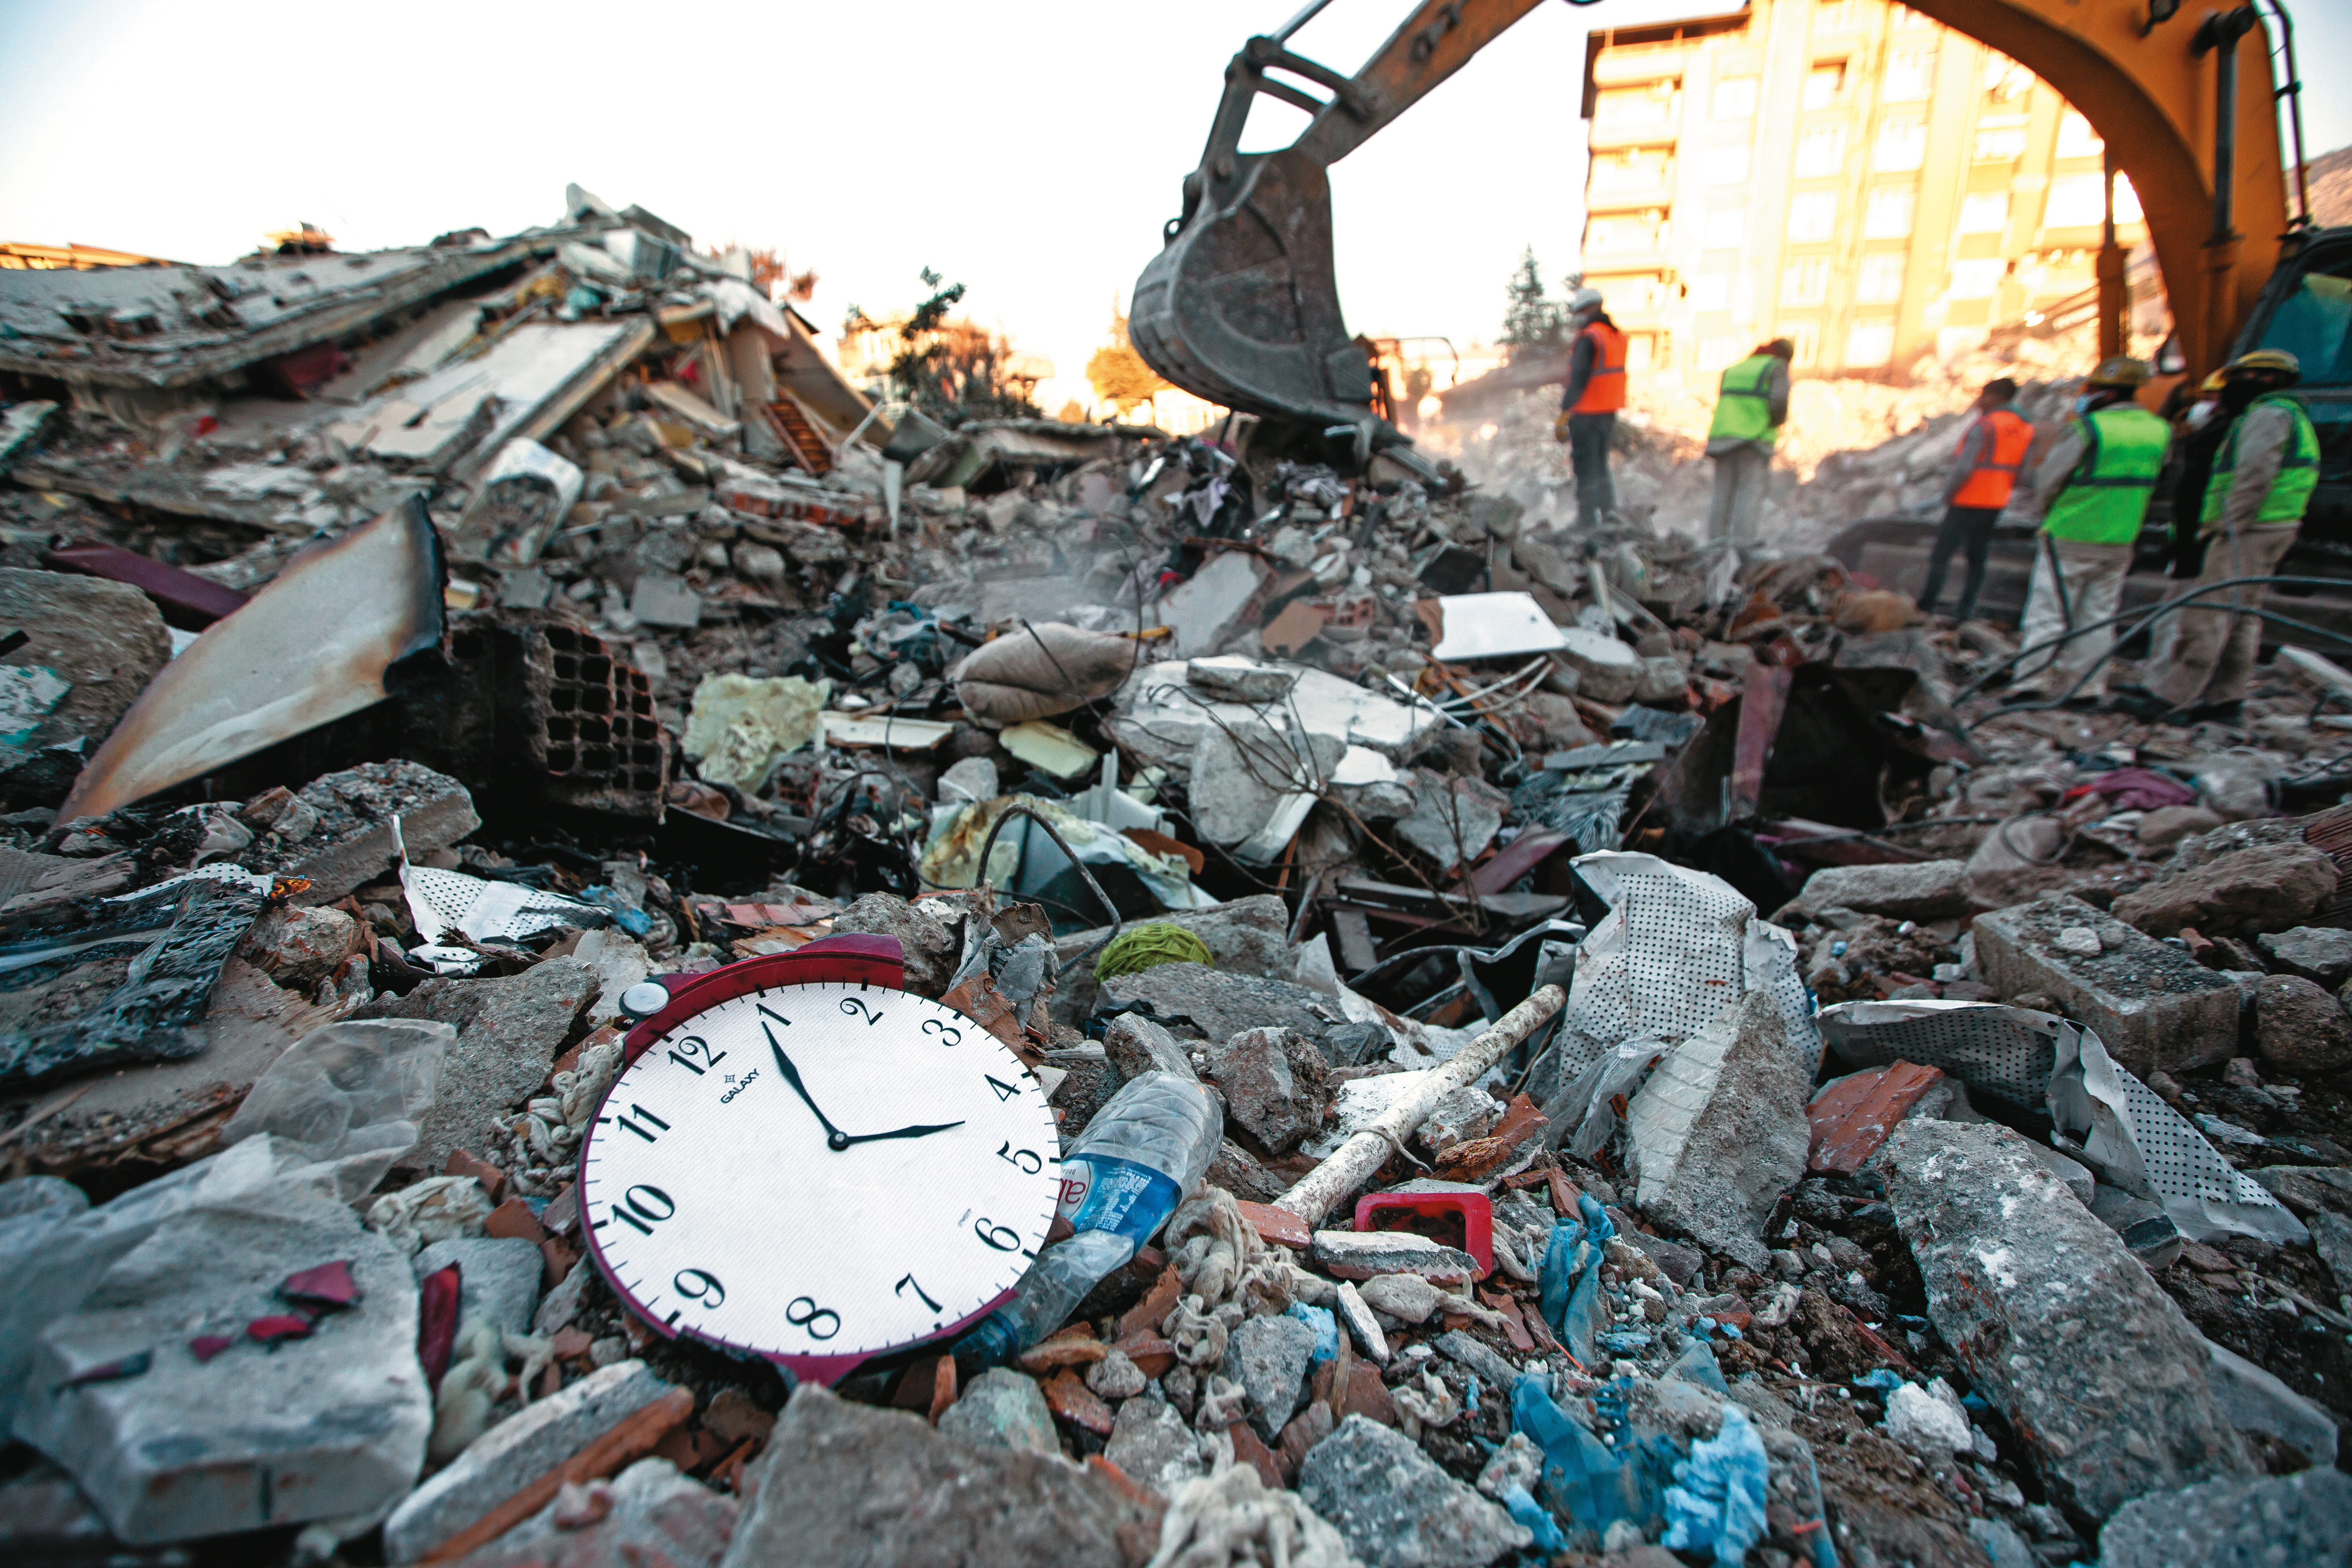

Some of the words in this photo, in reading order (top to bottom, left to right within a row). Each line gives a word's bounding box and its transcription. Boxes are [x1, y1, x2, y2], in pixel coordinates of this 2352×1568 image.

[756, 1003, 792, 1026] 1
[840, 998, 884, 1026] 2
[921, 1019, 961, 1047] 3
[668, 1036, 727, 1075] 12
[720, 1068, 760, 1103] GALAXY
[984, 1074, 1021, 1102] 4
[617, 1103, 671, 1143] 11
[997, 1140, 1042, 1175] 5
[612, 1185, 675, 1236] 10
[975, 1218, 1020, 1252] 6
[674, 1269, 725, 1309] 9
[895, 1273, 943, 1314] 7
[786, 1296, 841, 1340] 8
